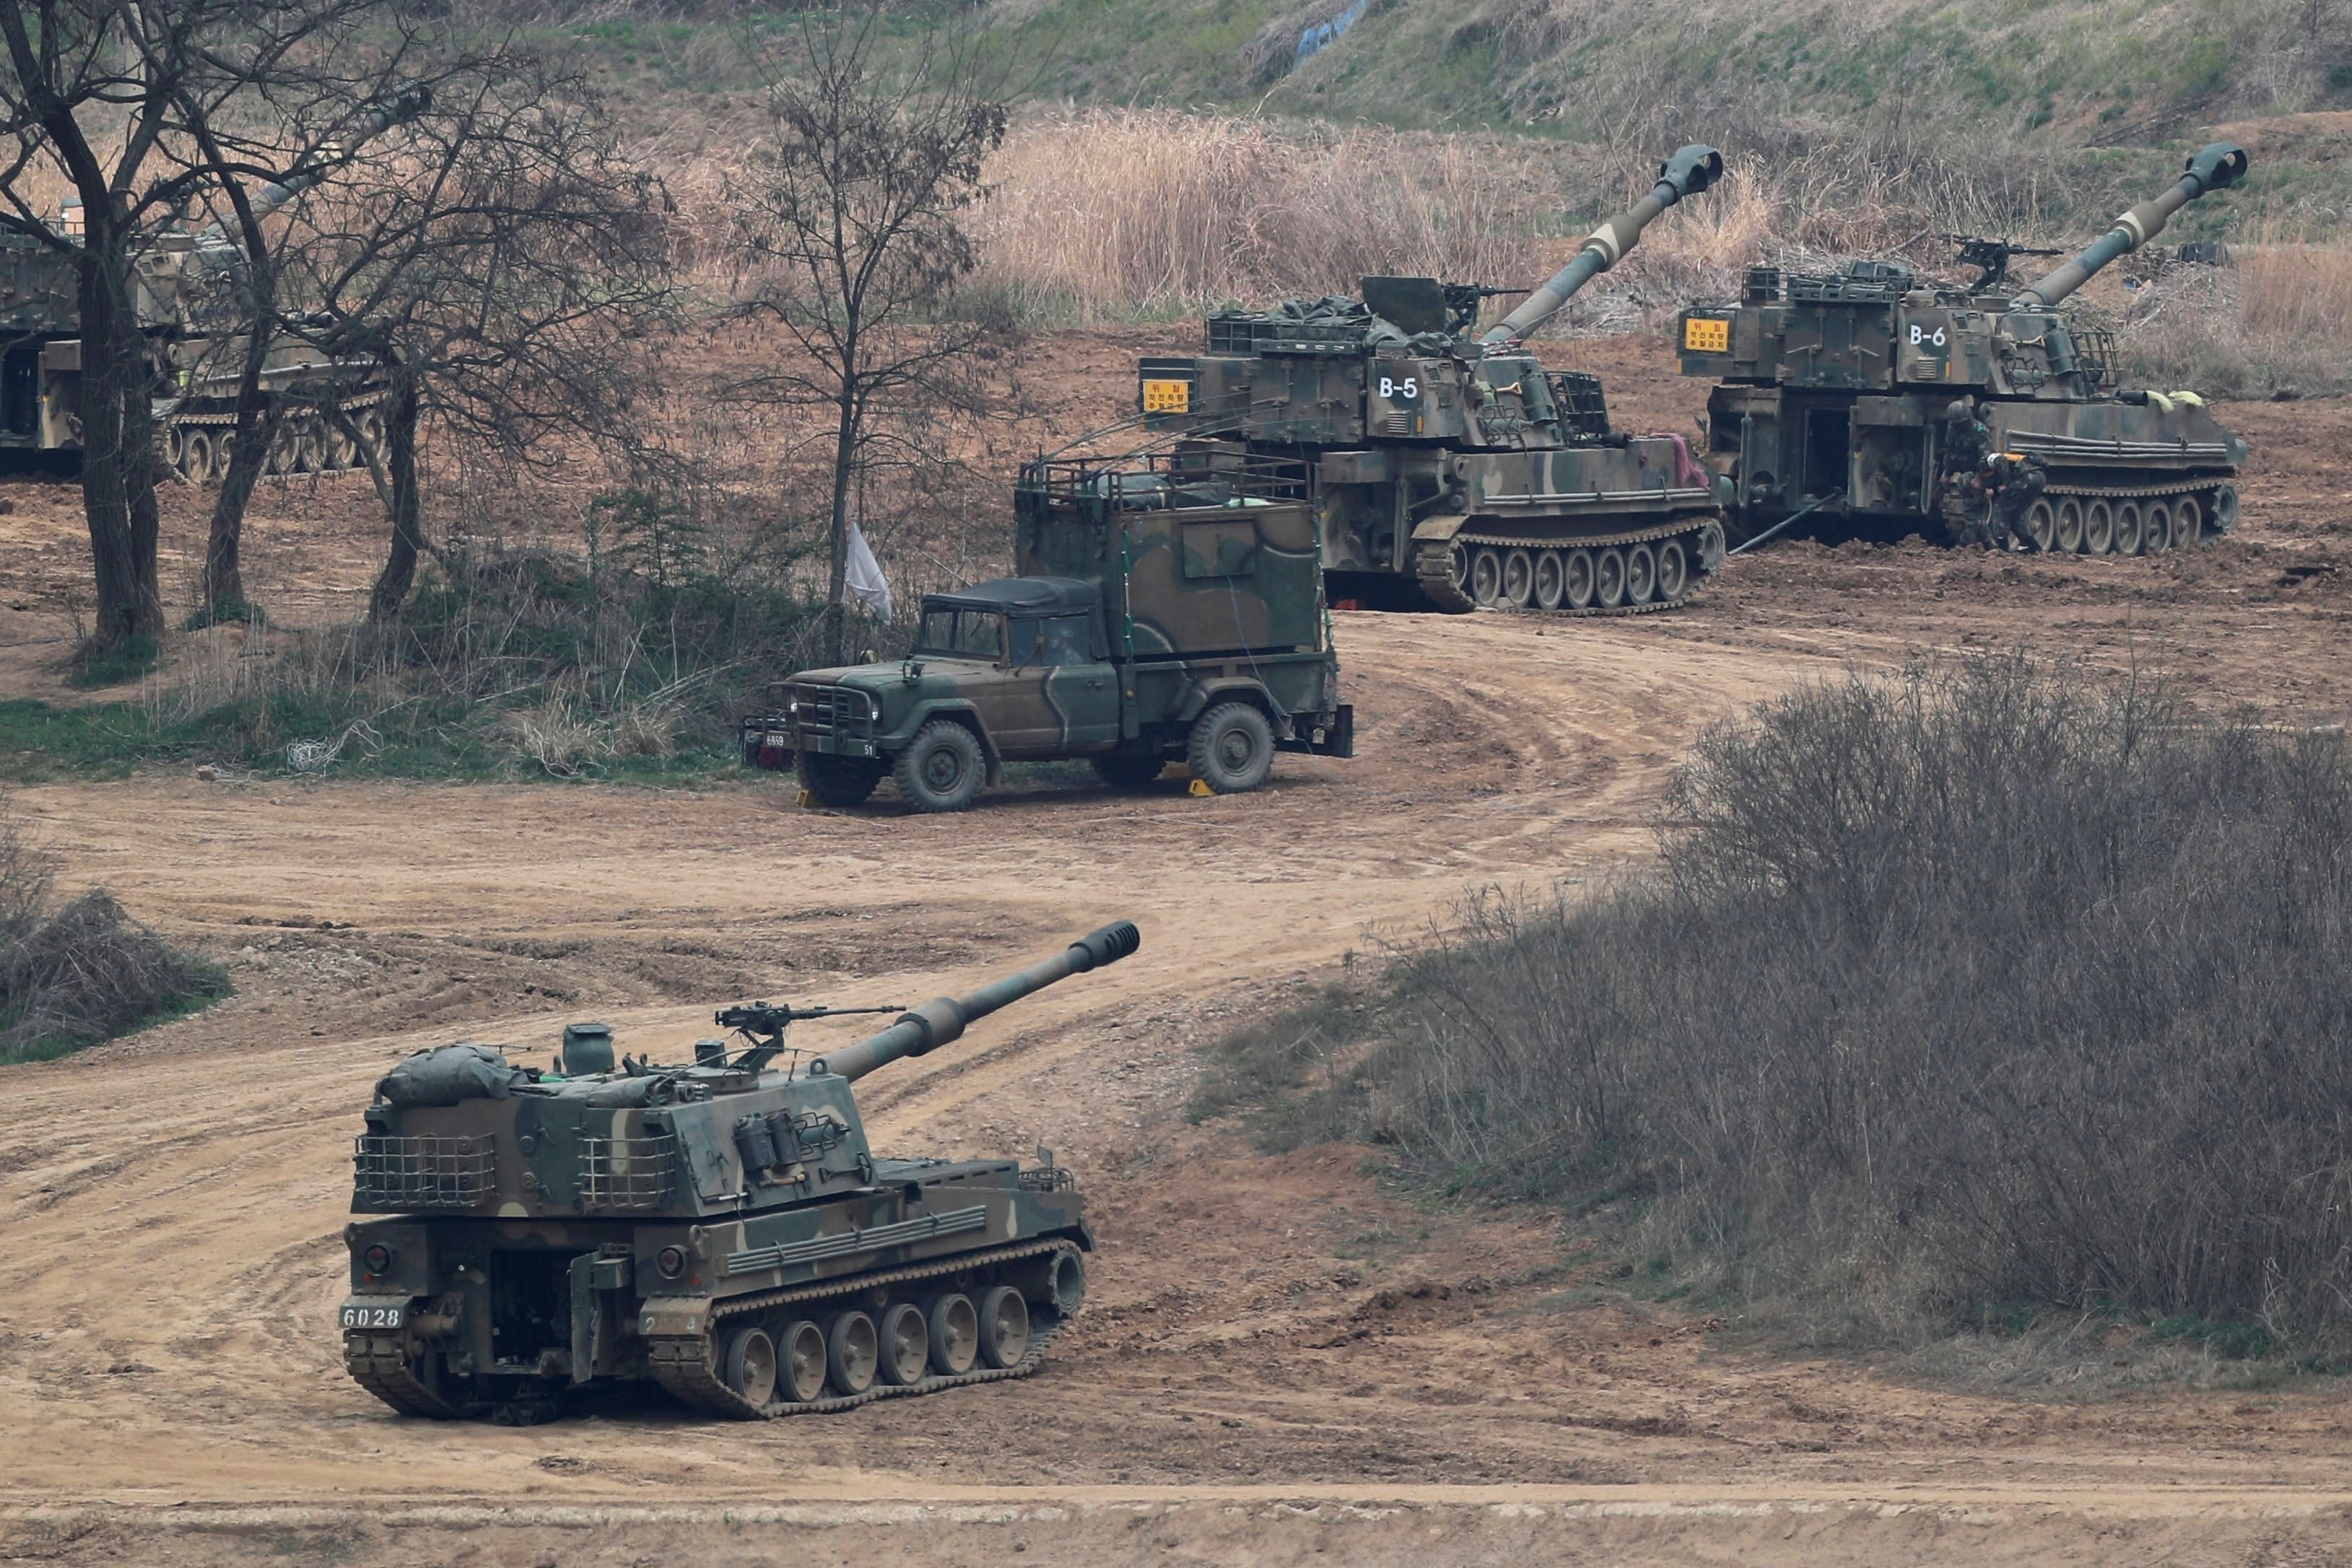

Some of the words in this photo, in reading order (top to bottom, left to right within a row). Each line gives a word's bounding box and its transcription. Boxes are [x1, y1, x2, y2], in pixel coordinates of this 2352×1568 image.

[1910, 324, 1946, 347] B-6
[1380, 377, 1418, 398] B-5
[864, 744, 873, 756] 51
[343, 1309, 399, 1327] 6028
